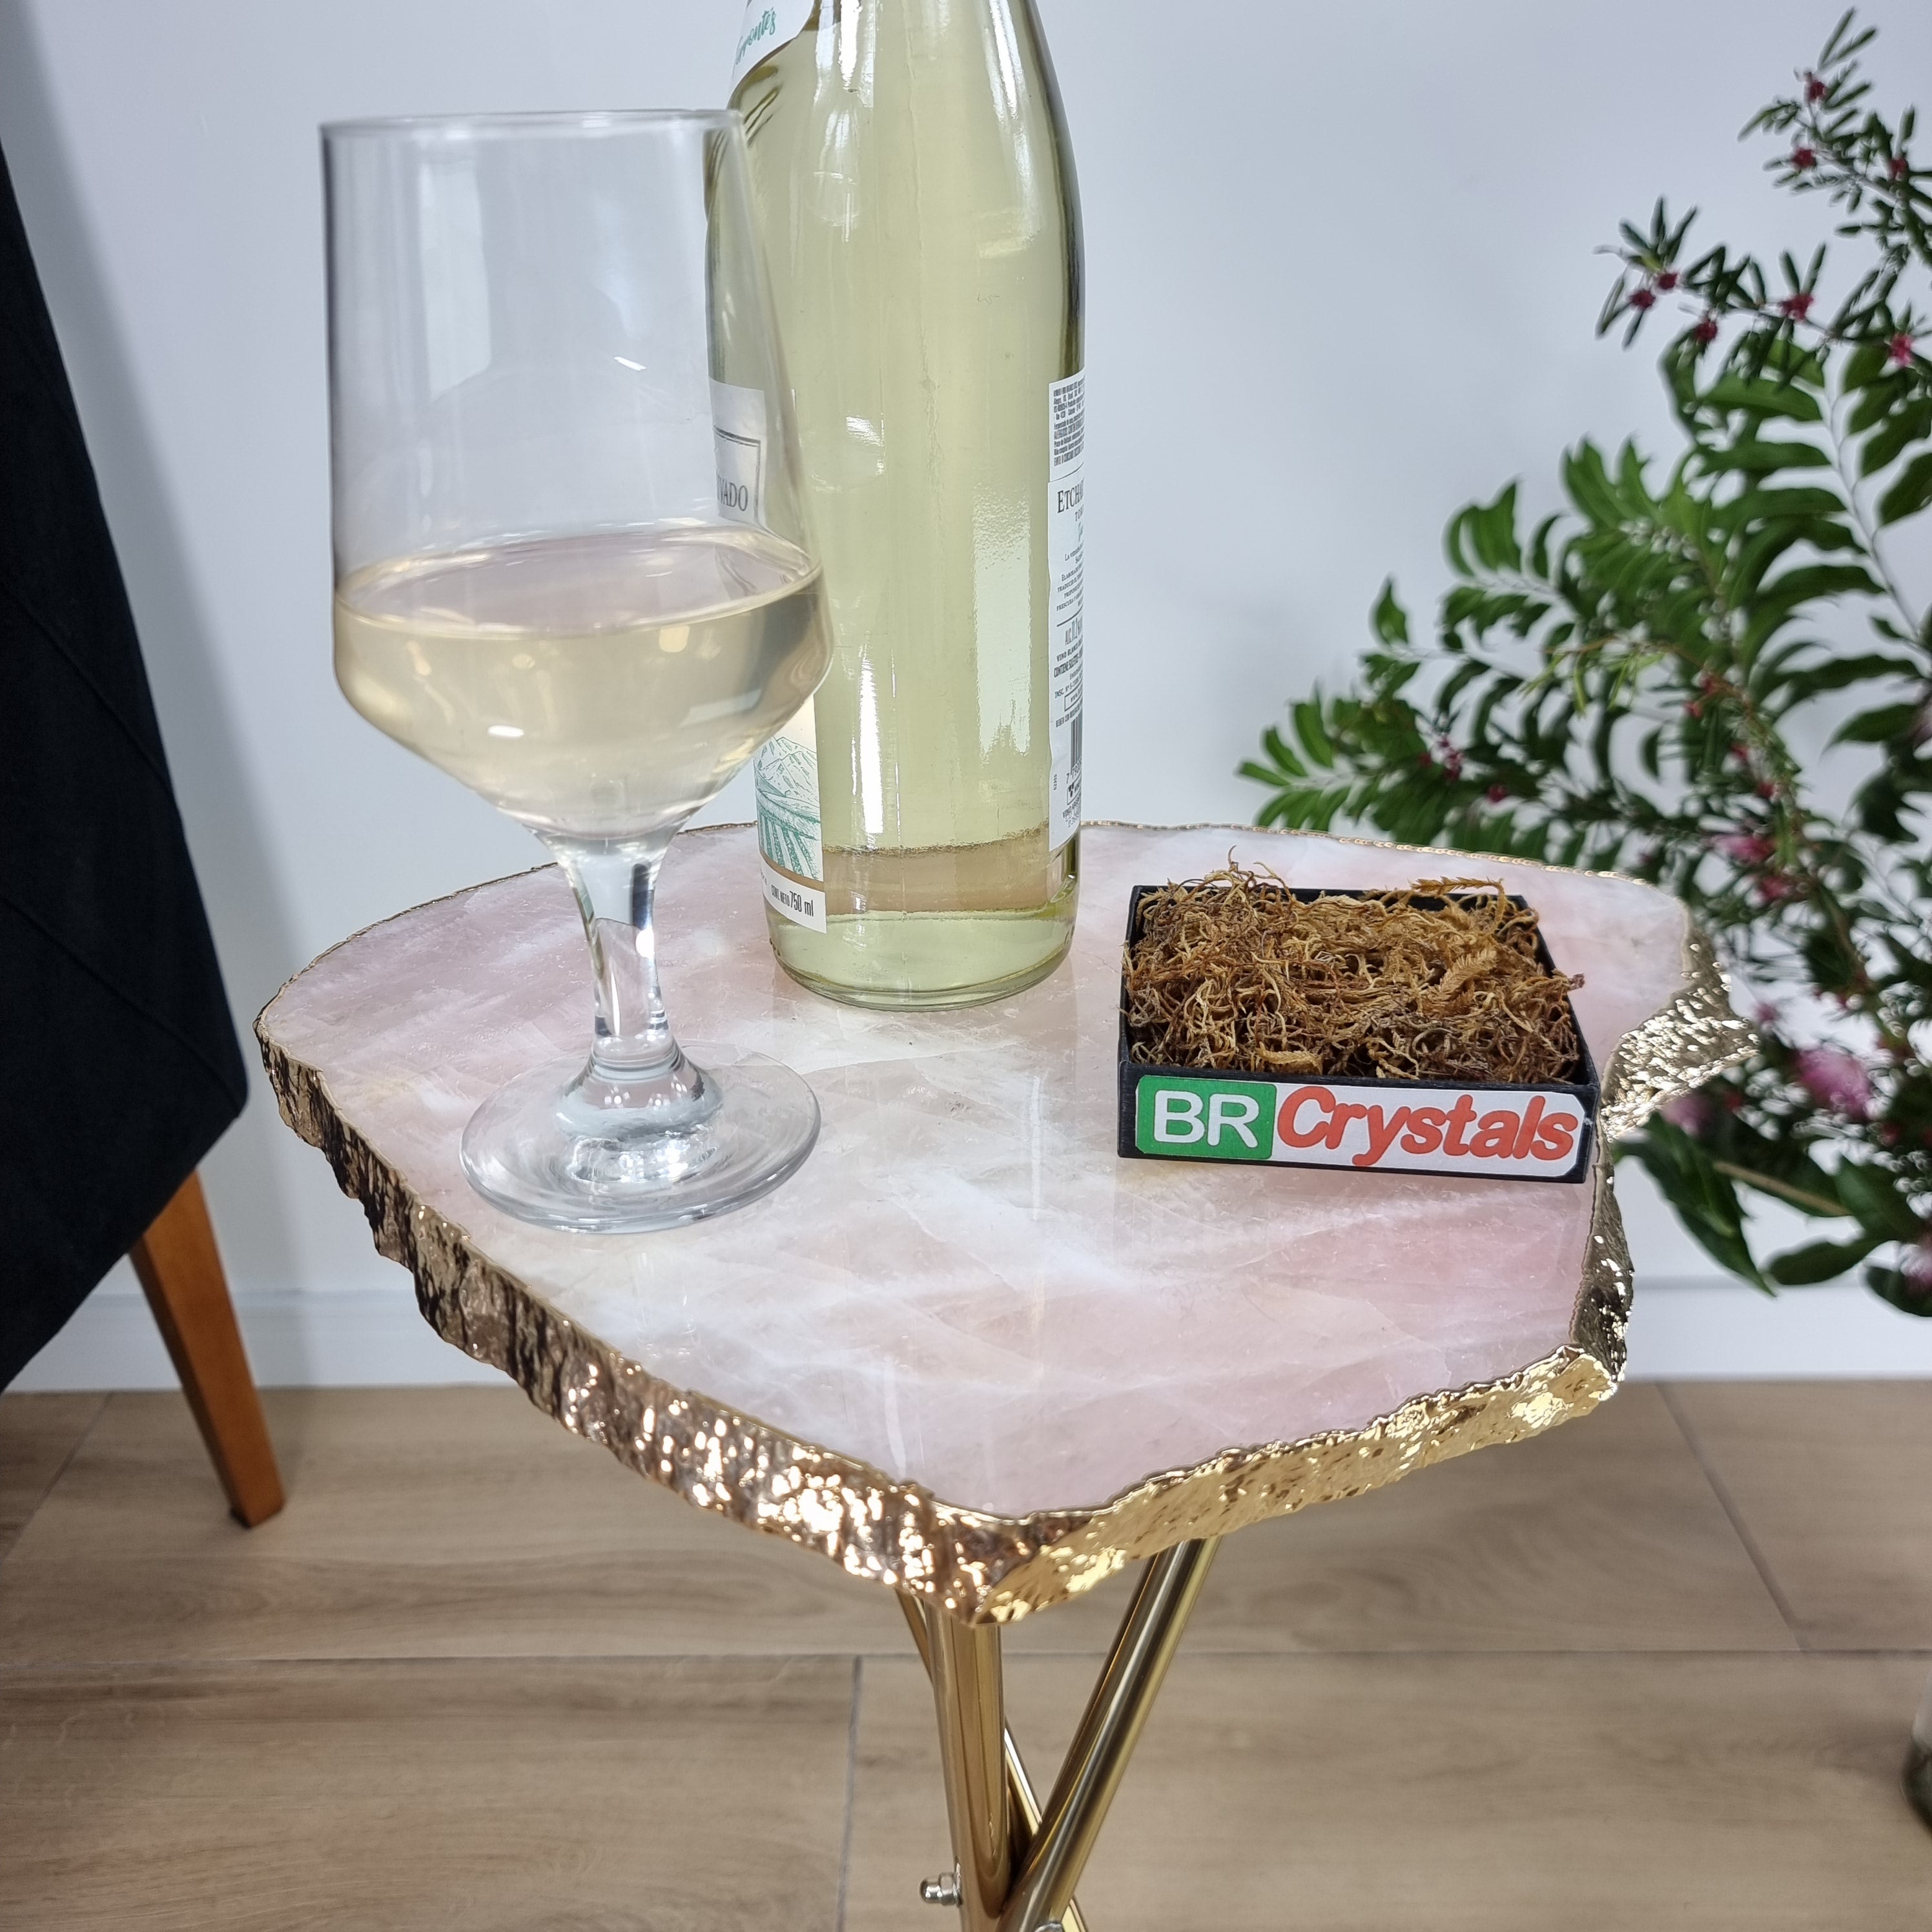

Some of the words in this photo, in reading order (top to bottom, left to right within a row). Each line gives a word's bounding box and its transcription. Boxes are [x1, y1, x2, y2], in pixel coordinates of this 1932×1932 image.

[780, 891, 790, 907] NETO
[790, 890, 802, 912] 750
[804, 899, 814, 917] ml
[1153, 1089, 1260, 1147] BR
[1276, 1085, 1579, 1166] Crystals
